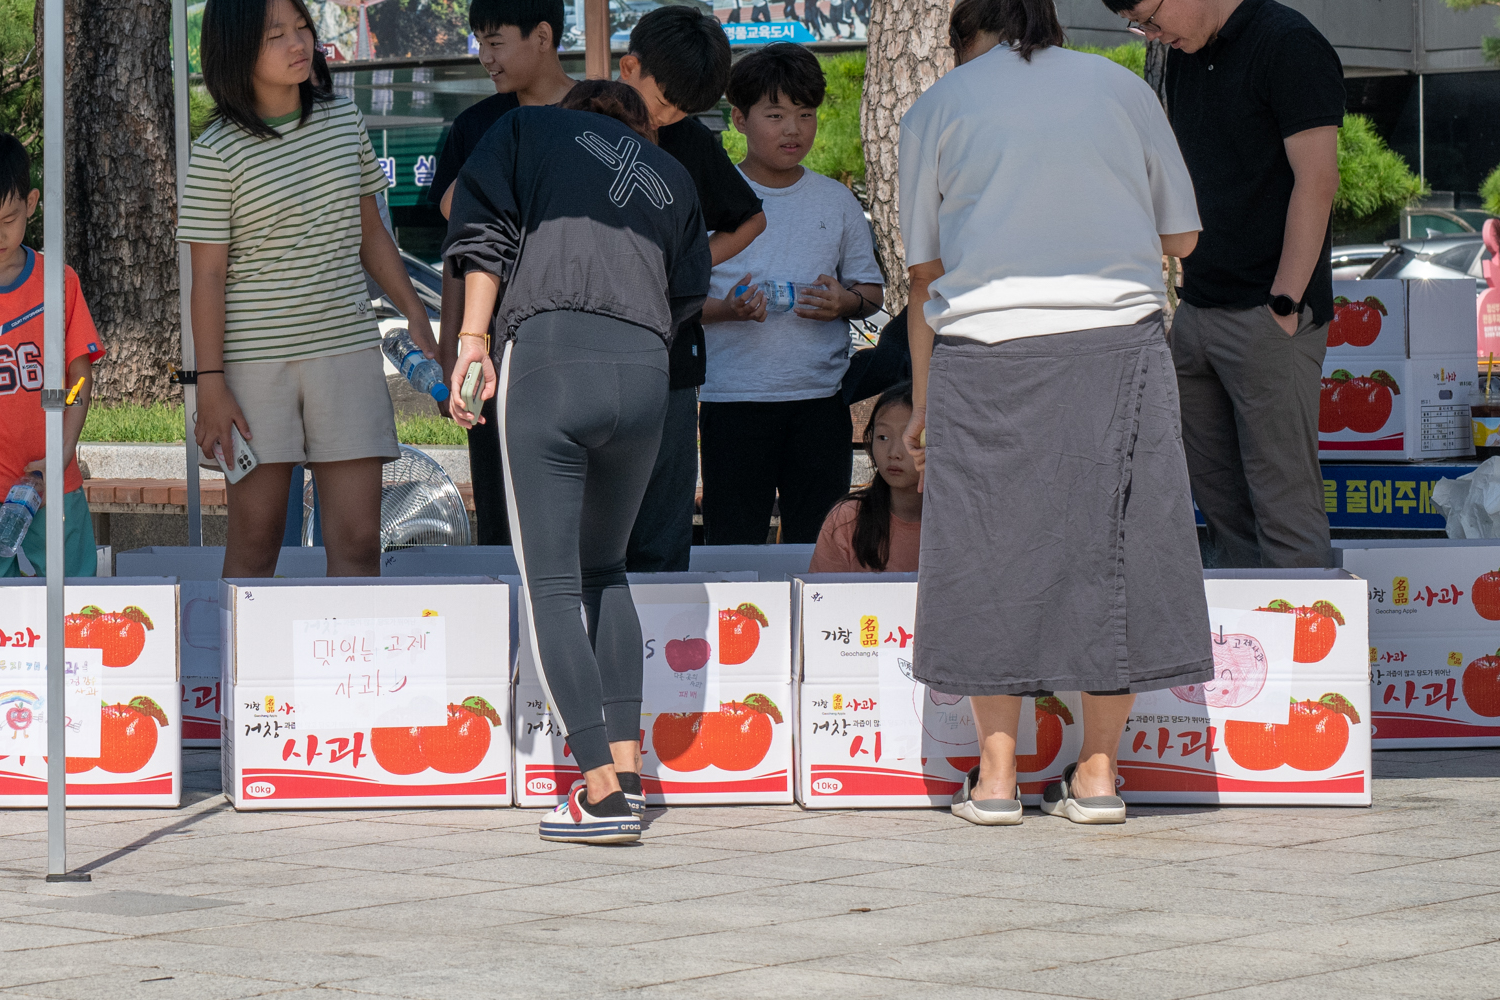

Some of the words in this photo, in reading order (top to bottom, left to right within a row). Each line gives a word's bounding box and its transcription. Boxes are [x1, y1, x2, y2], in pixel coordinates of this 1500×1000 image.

[1345, 479, 1439, 514] 줄여주세
[1413, 583, 1464, 607] 사과
[821, 626, 852, 645] 거창
[861, 618, 878, 646] 名品
[884, 626, 914, 648] 사
[313, 635, 374, 666] 맛있는
[387, 632, 427, 652] 고제
[1380, 650, 1408, 663] 사과
[1416, 669, 1433, 677] 당도가
[1434, 669, 1451, 677] 뛰어난
[1383, 678, 1459, 711] 사과
[244, 701, 261, 711] 거창
[278, 702, 296, 715] 사
[526, 700, 543, 709] 거창
[811, 699, 829, 709] 거창
[845, 698, 877, 711] 사과
[1135, 715, 1155, 723] 과즙이
[1156, 715, 1170, 723] 많고
[1171, 715, 1191, 723] 당도가
[244, 720, 283, 739] 거창
[812, 719, 851, 736] 거창
[853, 719, 872, 728] 과즙이
[282, 731, 368, 769] 사과
[1132, 726, 1220, 763] 사과
[250, 785, 271, 794] 10kg
[530, 782, 553, 791] 10kg
[816, 781, 839, 790] 10kg
[620, 823, 641, 831] crocs
